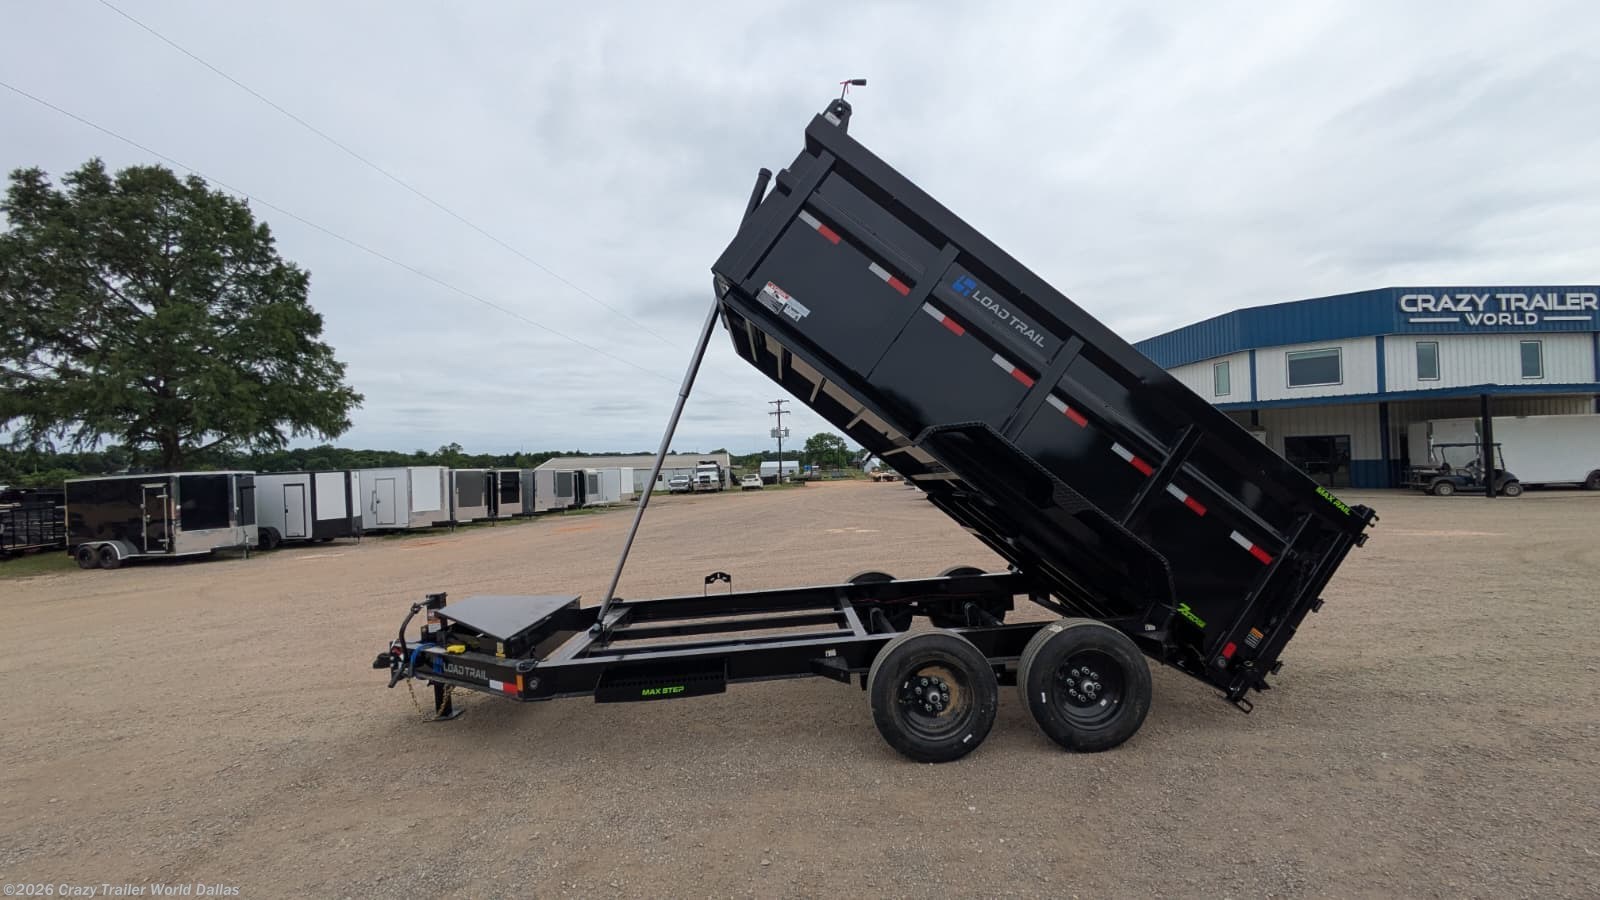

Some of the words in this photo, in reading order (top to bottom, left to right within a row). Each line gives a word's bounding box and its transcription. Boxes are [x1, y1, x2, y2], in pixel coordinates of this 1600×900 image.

[1400, 294, 1489, 312] CRAZY
[1496, 293, 1599, 311] TRAILER
[972, 290, 1010, 320] LOAD
[1009, 315, 1045, 348] TRAIL
[1465, 313, 1538, 326] WORLD
[443, 663, 464, 675] LOAD
[464, 666, 488, 681] TRAIL
[641, 688, 661, 696] MAX
[662, 686, 685, 694] STEP
